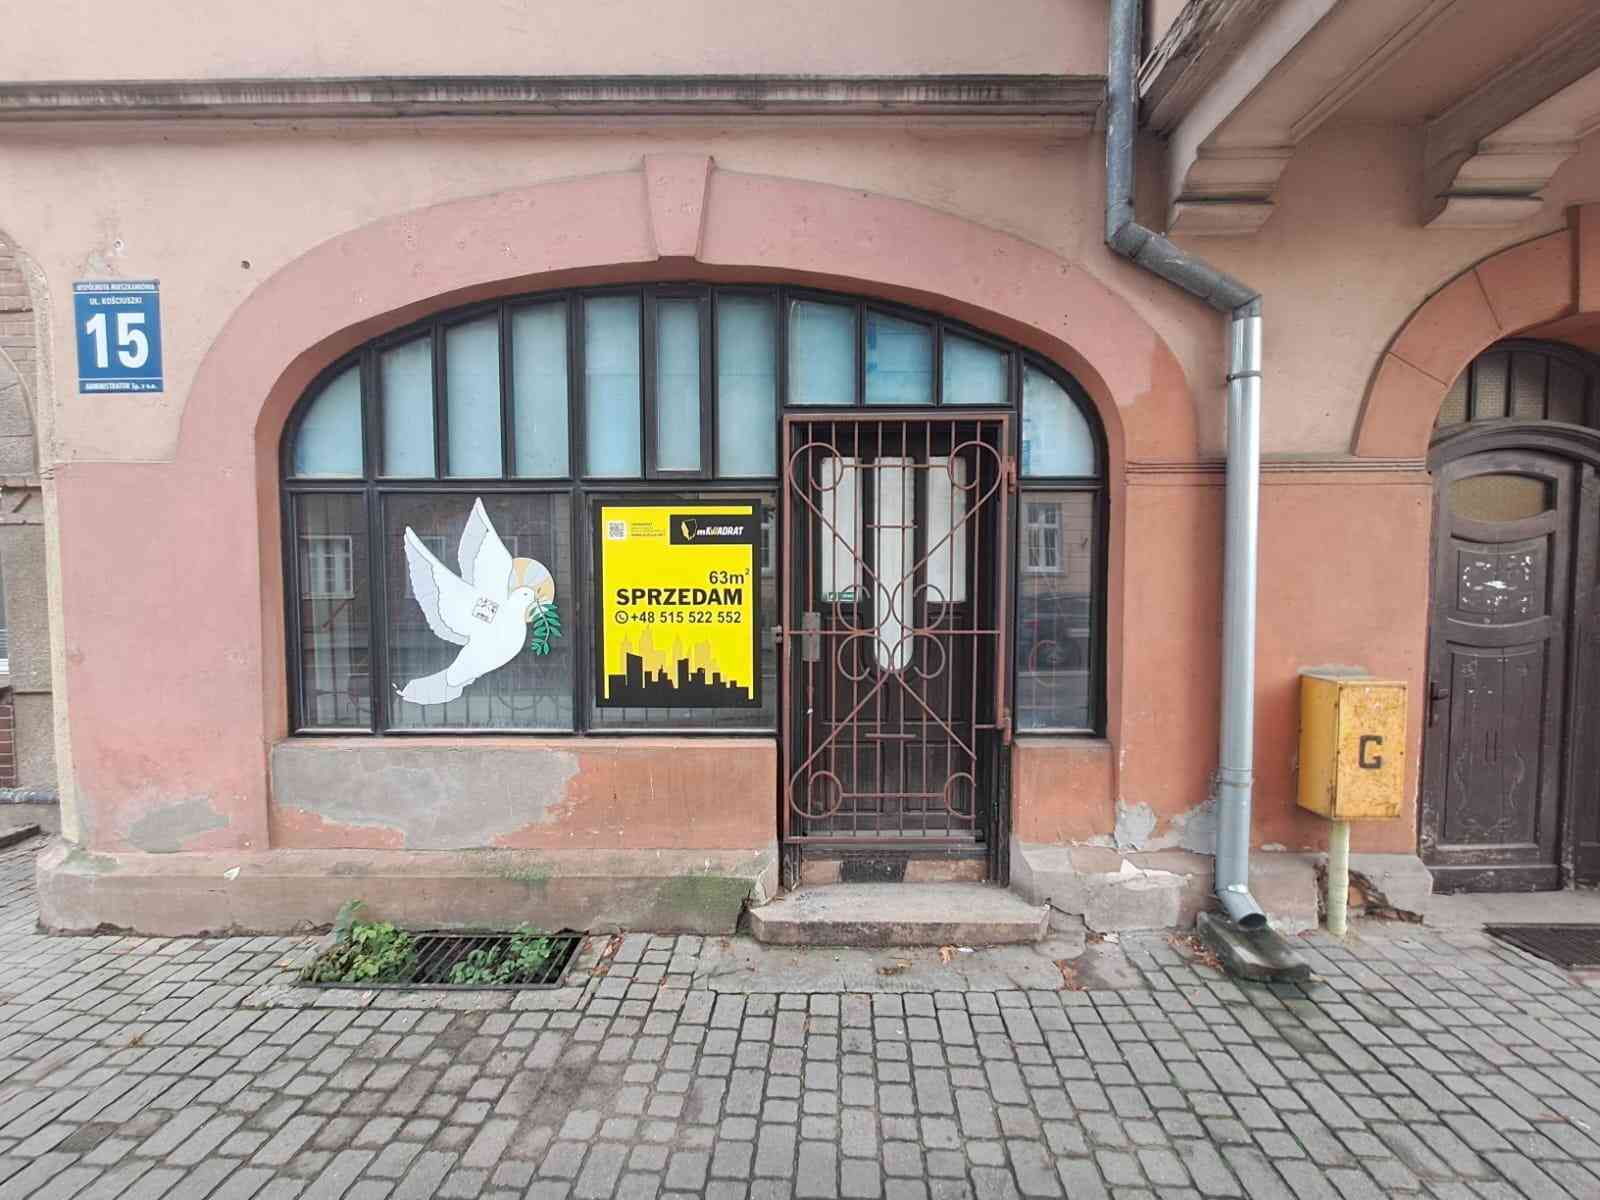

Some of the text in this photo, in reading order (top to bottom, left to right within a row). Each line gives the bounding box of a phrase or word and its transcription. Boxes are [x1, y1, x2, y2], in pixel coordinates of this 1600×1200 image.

[102, 295, 142, 304] KOŚCIUSZKI
[86, 312, 149, 369] 15
[616, 588, 743, 606] SPRZEDAM
[631, 611, 741, 624] +48 515 522 552
[1358, 735, 1383, 769] G
